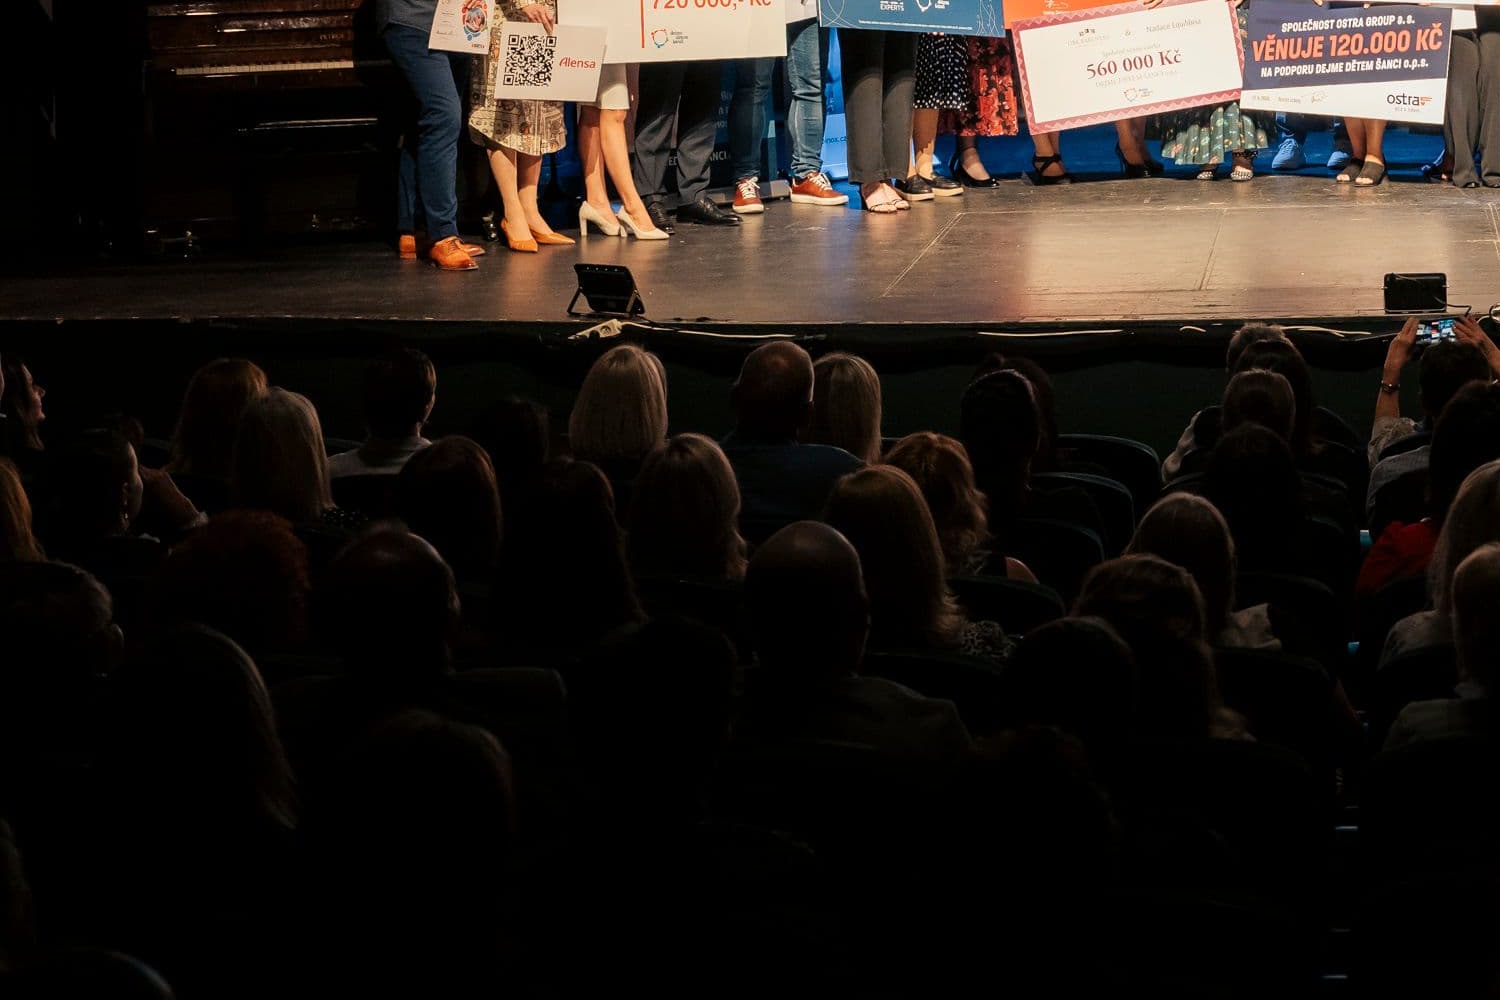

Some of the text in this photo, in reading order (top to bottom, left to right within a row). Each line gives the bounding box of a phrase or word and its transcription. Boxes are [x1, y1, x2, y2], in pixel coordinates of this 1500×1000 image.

[1281, 18, 1335, 33] SPOLEČNOST
[1336, 17, 1364, 30] OSTRA
[1365, 15, 1395, 27] GROUP
[1252, 22, 1444, 62] VĚNUJE 120.000 KČ
[559, 56, 597, 70] Alensa
[1087, 60, 1117, 79] 560
[1123, 54, 1153, 72] 000
[1158, 48, 1182, 67] Kč
[1261, 58, 1429, 78] NA PODPORU DEJME DĚTEM ŠANCI o.p.s.
[1387, 92, 1420, 106] ostra
